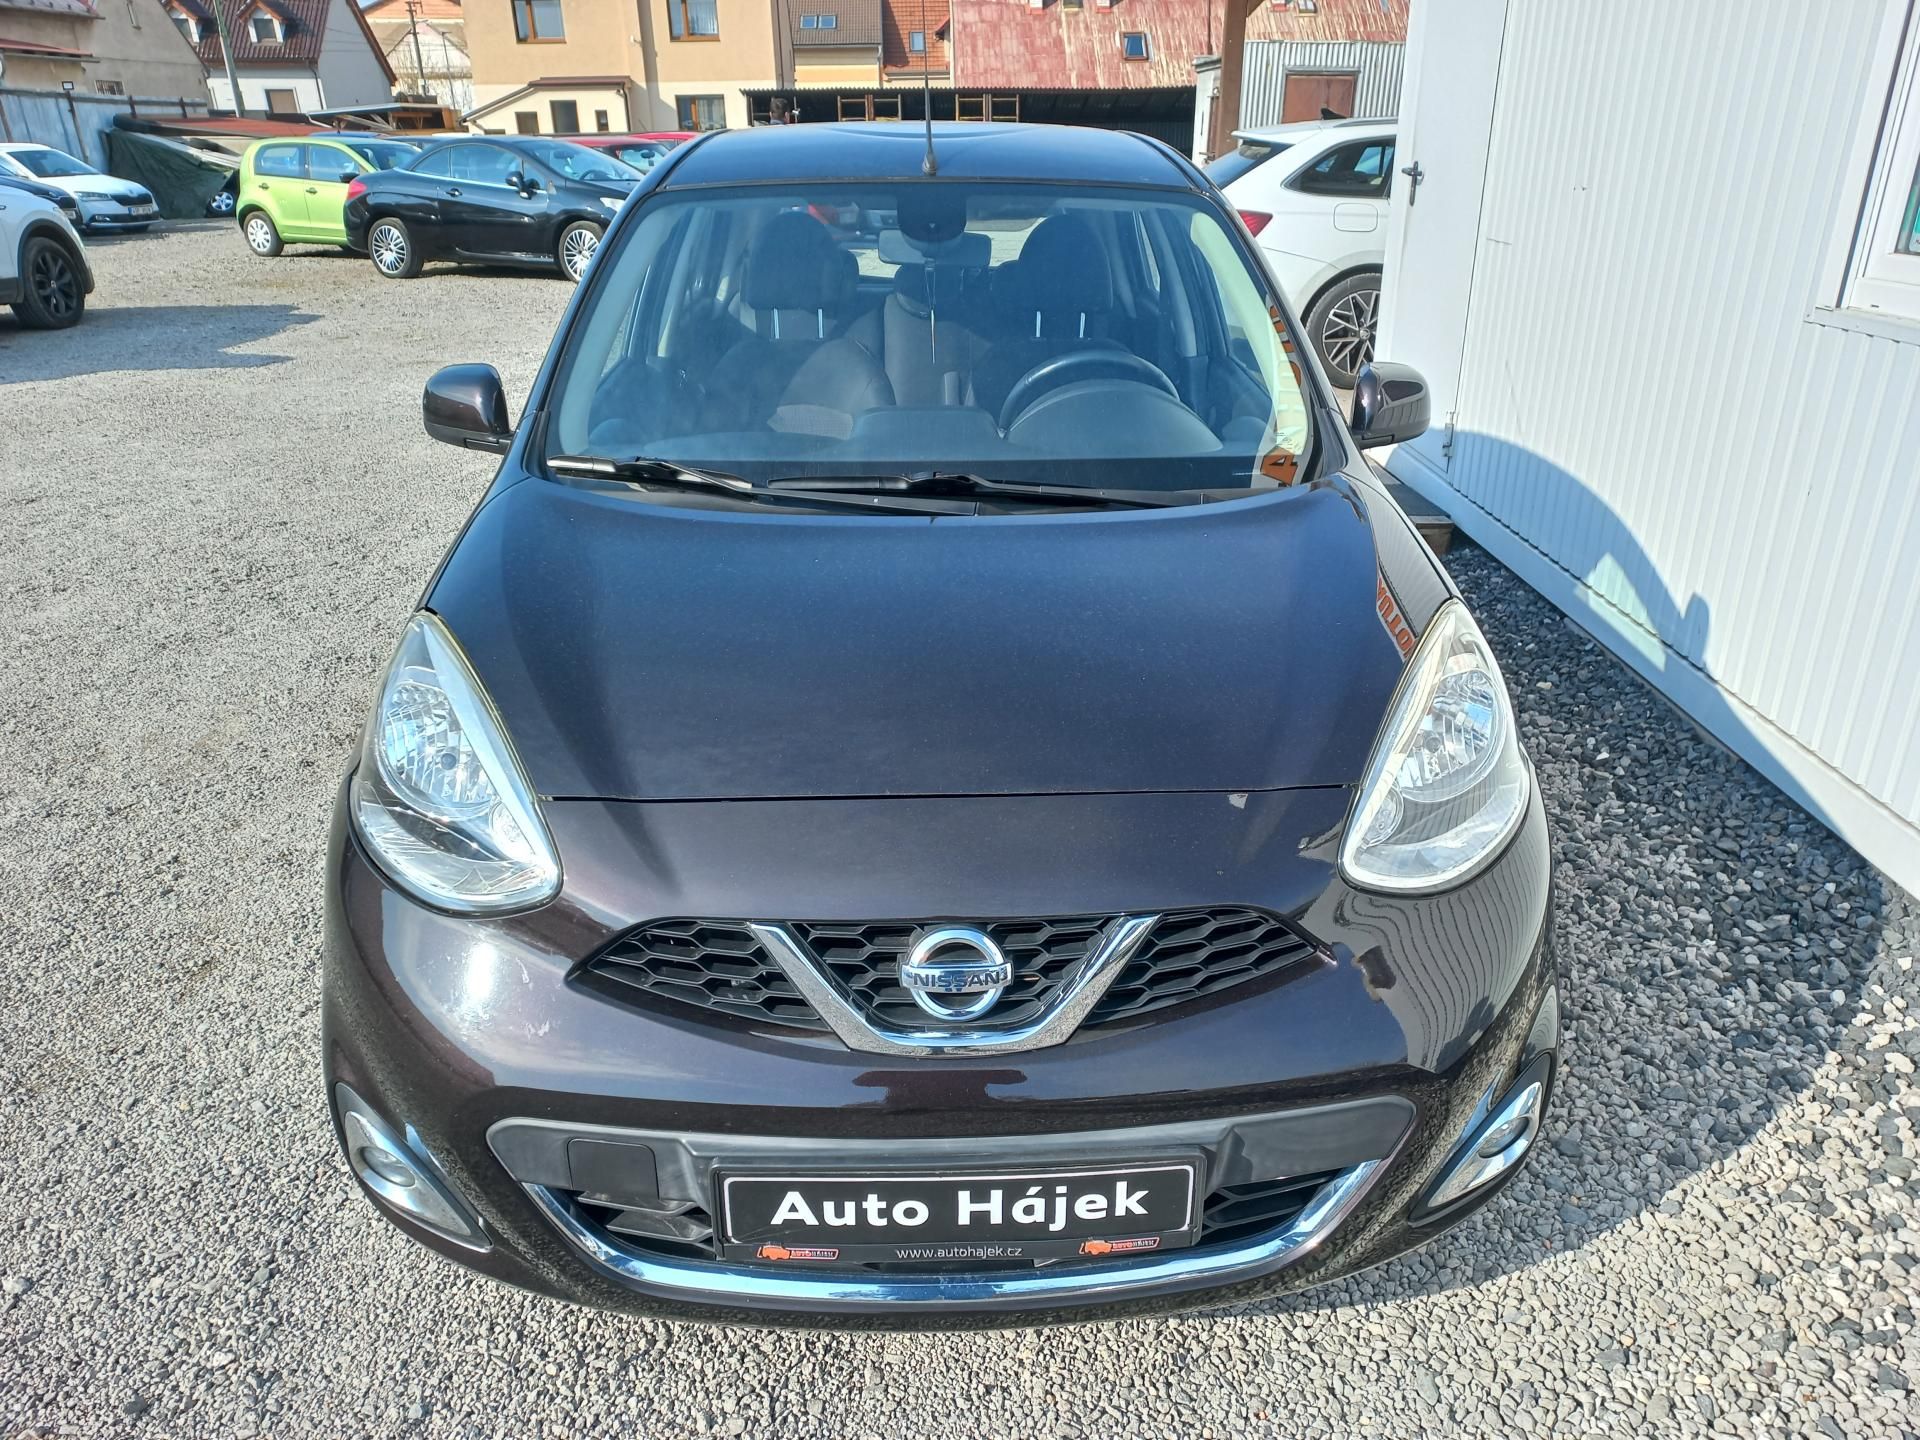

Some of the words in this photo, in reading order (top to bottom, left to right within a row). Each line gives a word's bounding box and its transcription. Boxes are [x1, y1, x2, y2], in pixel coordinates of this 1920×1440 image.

[913, 971, 1000, 988] NISSAN
[770, 1190, 930, 1227] Auto
[957, 1181, 1149, 1232] Hájek
[896, 1245, 1022, 1259] www.autohajek.cz
